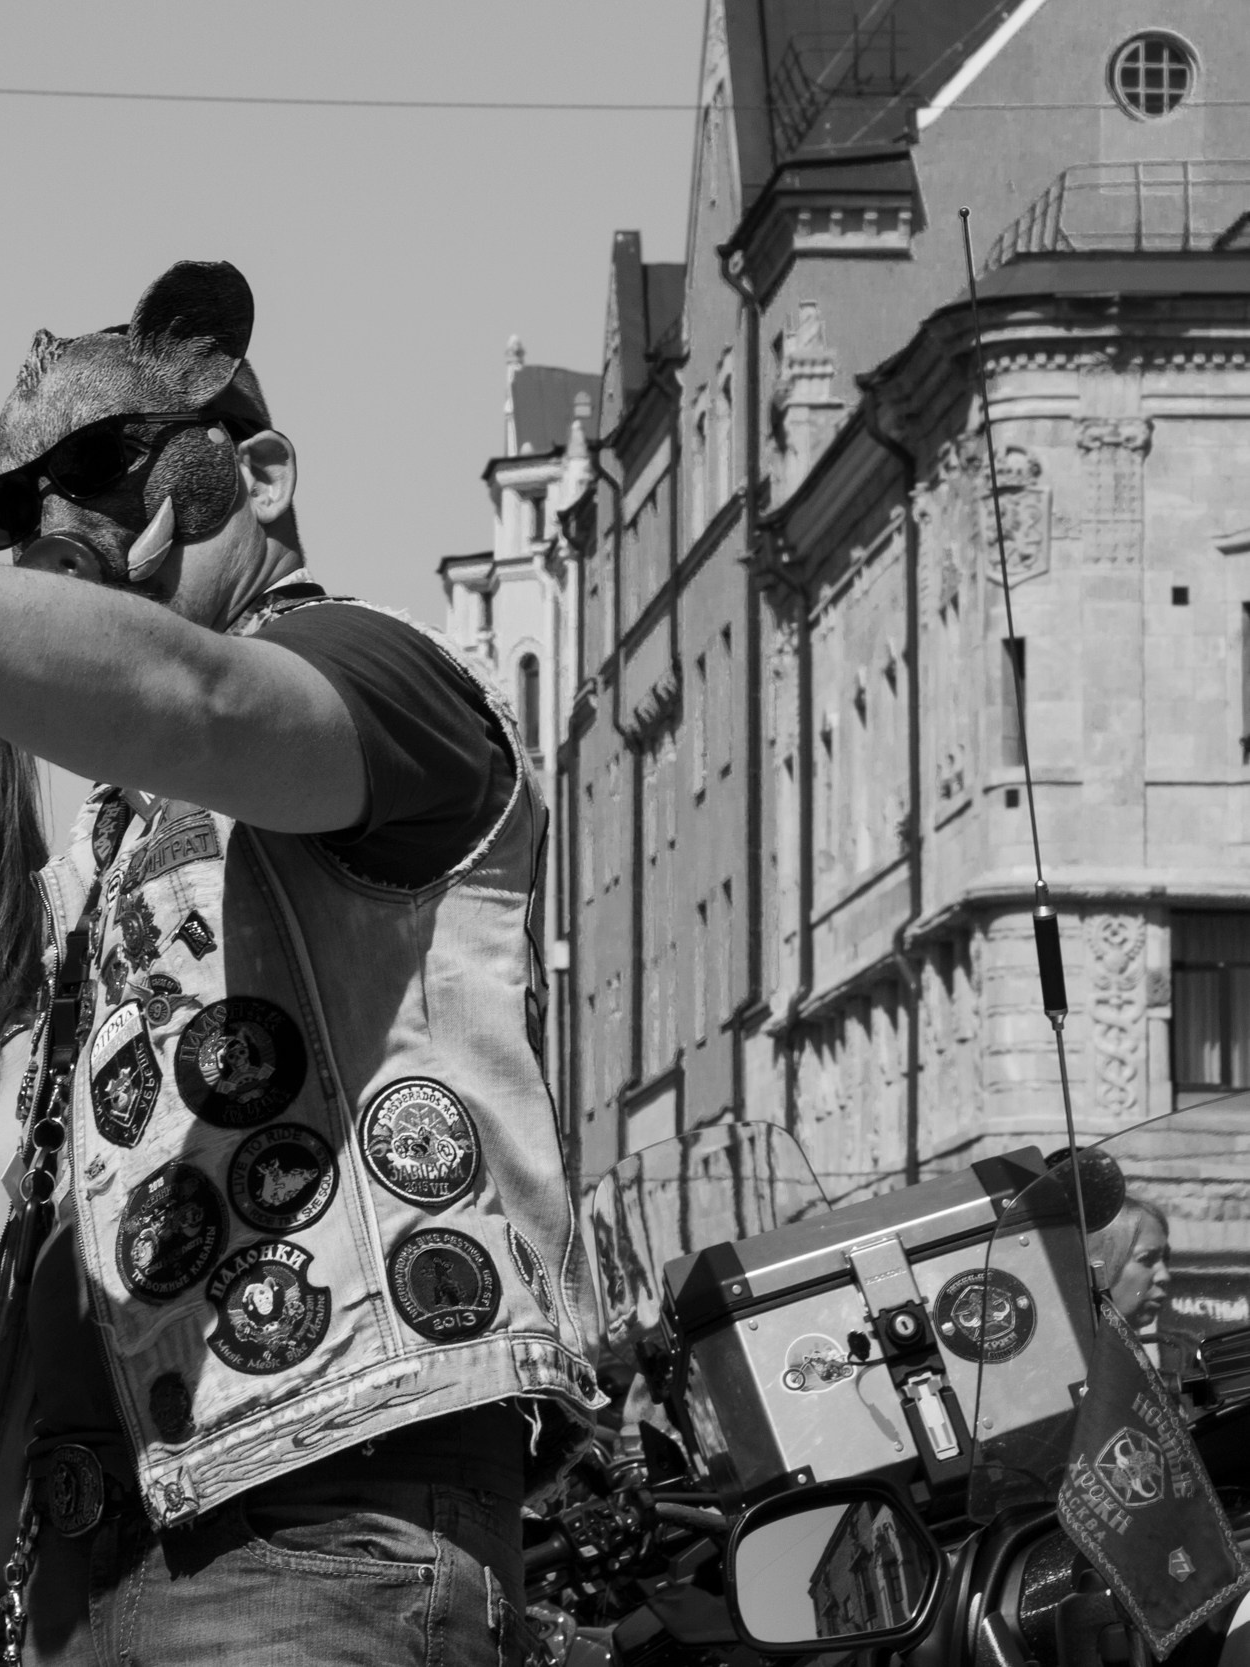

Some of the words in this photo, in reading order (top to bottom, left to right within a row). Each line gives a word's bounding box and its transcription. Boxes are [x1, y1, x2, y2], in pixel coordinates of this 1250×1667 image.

[233, 1161, 248, 1195] LIVE
[243, 1139, 262, 1156] TO
[264, 1127, 303, 1144] RIDE
[249, 1208, 274, 1226] RIDE
[301, 1199, 323, 1218] SHE
[190, 1225, 217, 1276] КАБАНЫ
[415, 1232, 441, 1246] BIKE
[209, 1243, 308, 1299] ПАДОНКИ
[432, 1312, 477, 1331] 2013
[1171, 1552, 1191, 1574] 77
